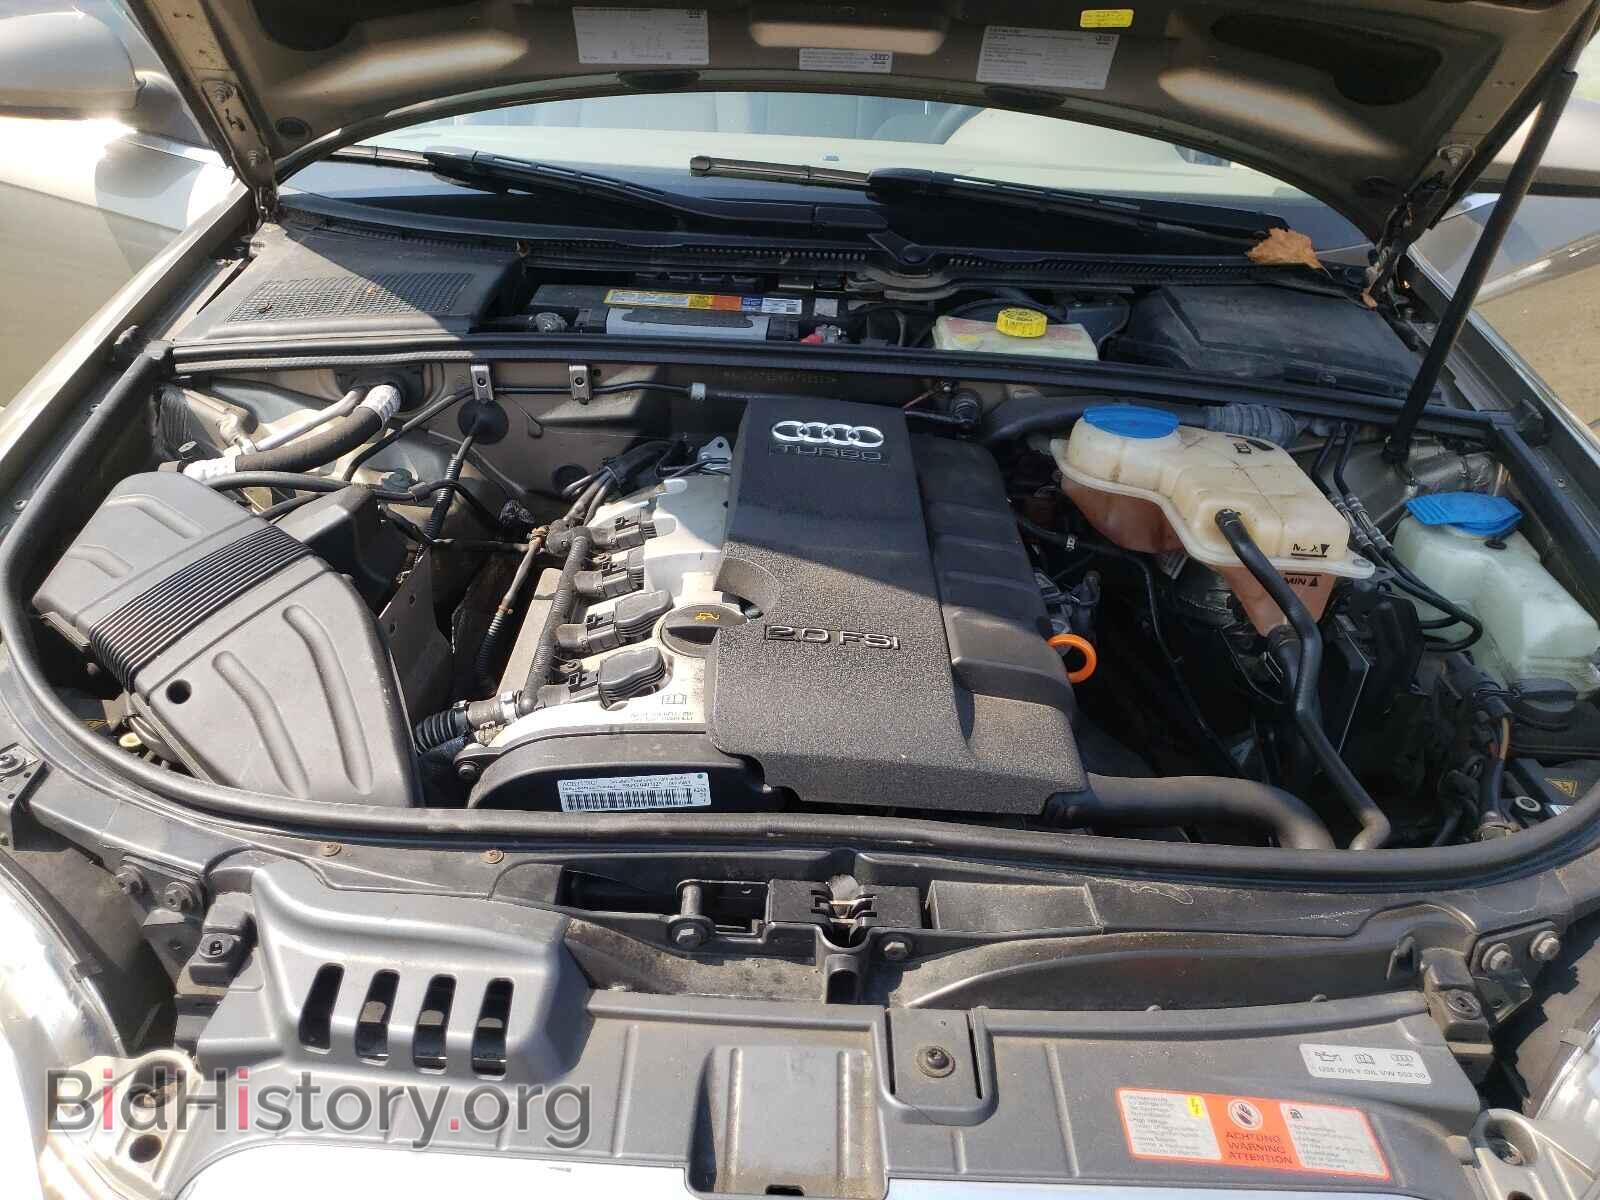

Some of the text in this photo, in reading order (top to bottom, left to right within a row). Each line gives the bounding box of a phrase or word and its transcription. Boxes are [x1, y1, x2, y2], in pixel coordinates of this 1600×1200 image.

[839, 630, 900, 650] FSI
[1225, 1131, 1281, 1143] ACHTUNG
[1228, 1142, 1286, 1154] WARNING
[1229, 1152, 1293, 1164] ATTENTION
